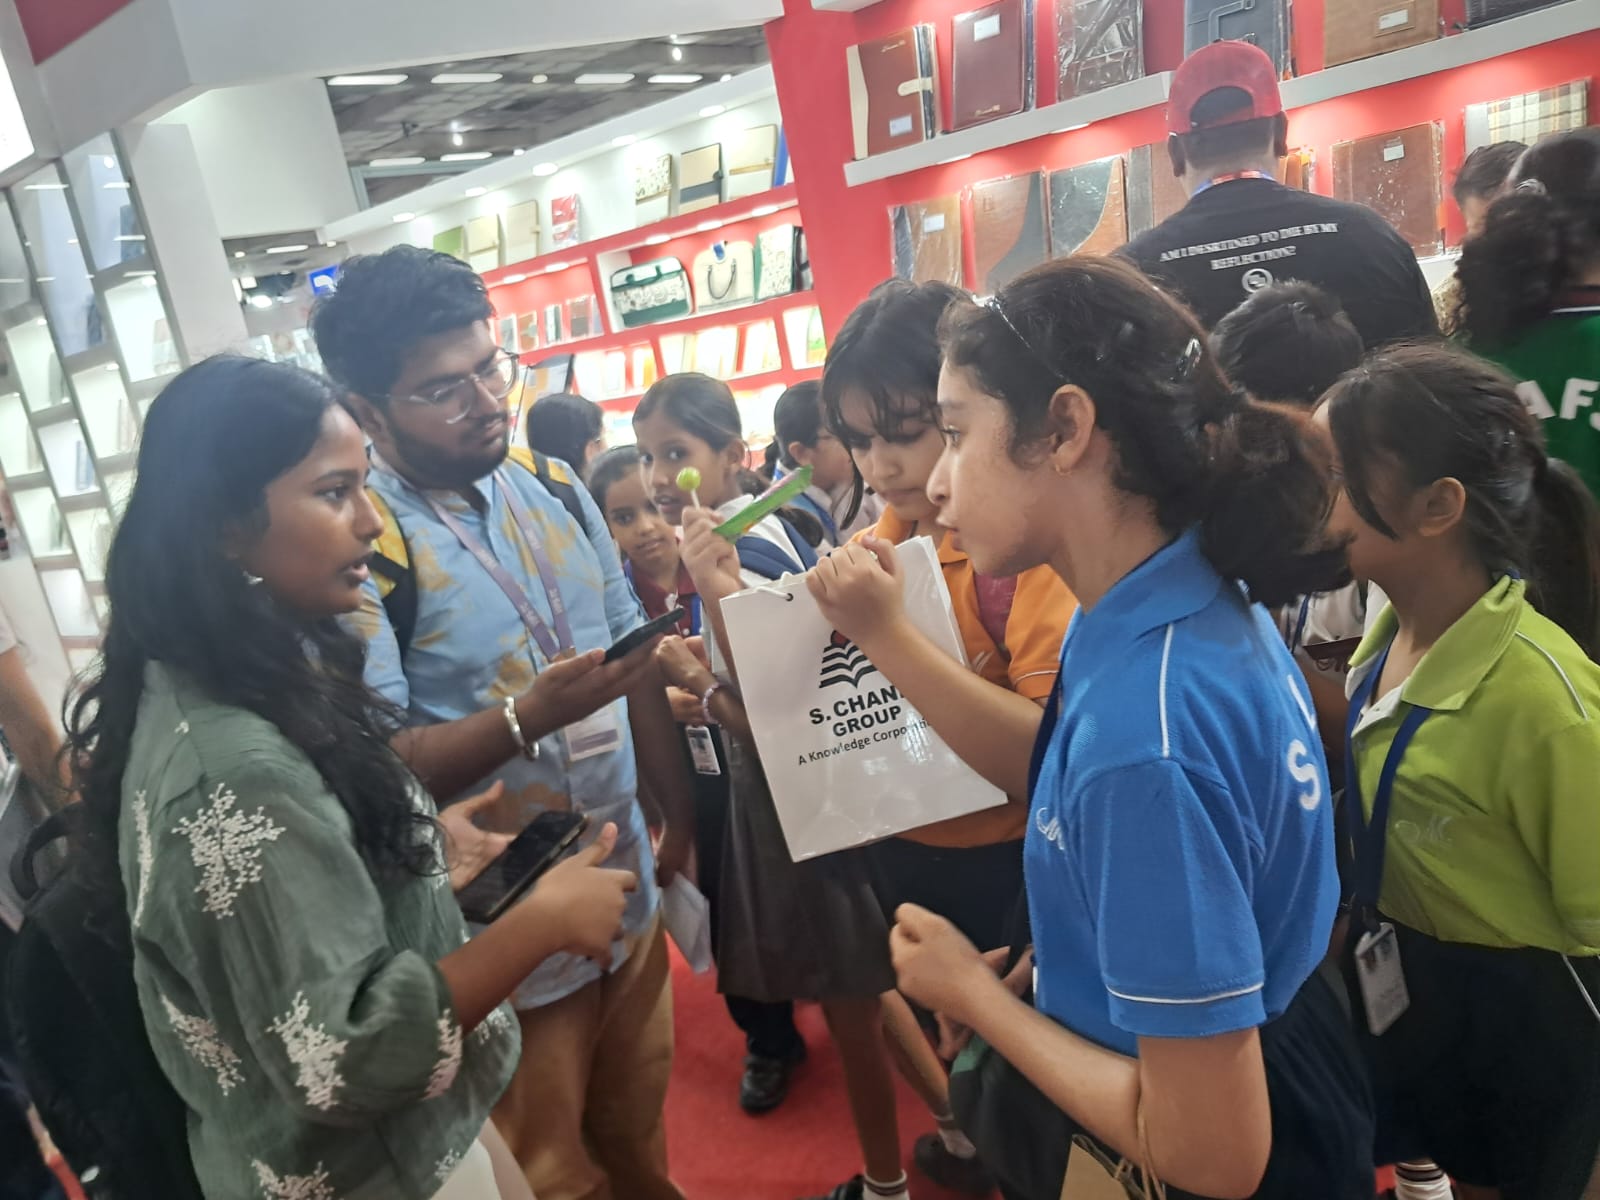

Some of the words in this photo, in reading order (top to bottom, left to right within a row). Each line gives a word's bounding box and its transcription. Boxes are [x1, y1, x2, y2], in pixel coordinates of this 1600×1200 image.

[1261, 231, 1279, 243] TO
[1514, 377, 1600, 432] AF
[809, 707, 832, 725] S.
[833, 685, 905, 717] CHAN
[832, 705, 902, 737] GROUP
[798, 755, 808, 766] A
[808, 735, 871, 763] Knowledge
